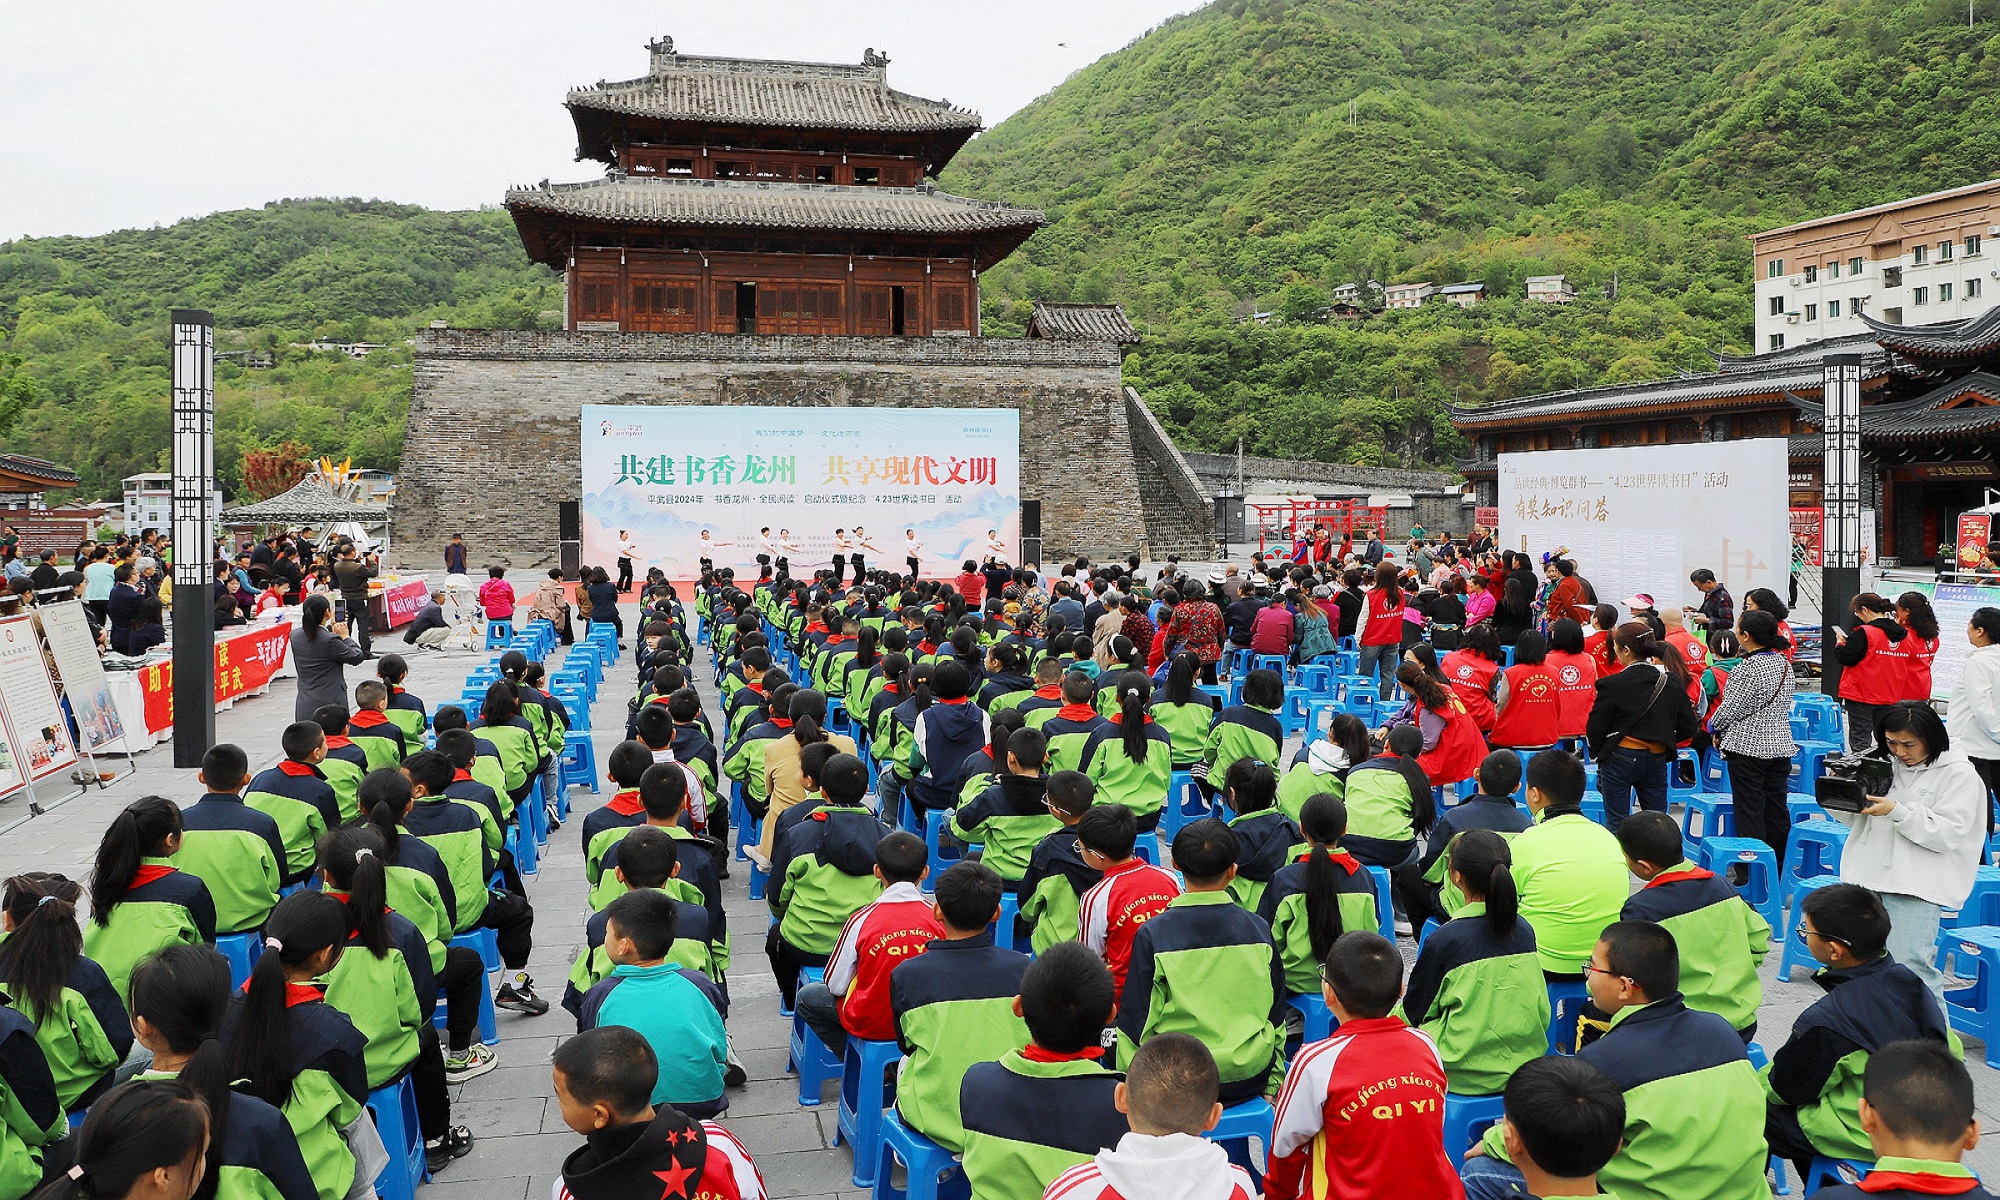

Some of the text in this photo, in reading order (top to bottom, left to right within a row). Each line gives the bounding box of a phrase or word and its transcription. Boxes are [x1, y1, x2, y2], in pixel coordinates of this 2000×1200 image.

[614, 454, 997, 486] 共建书香龙州 共享现代文明
[1514, 493, 1610, 522] 有奖知识问答
[1147, 892, 1169, 901] xiao
[909, 926, 932, 938] xiao
[887, 945, 908, 956] QI
[1357, 1077, 1397, 1107] jiang
[1400, 1071, 1433, 1088] xiao
[1372, 1098, 1436, 1120] QI YI
